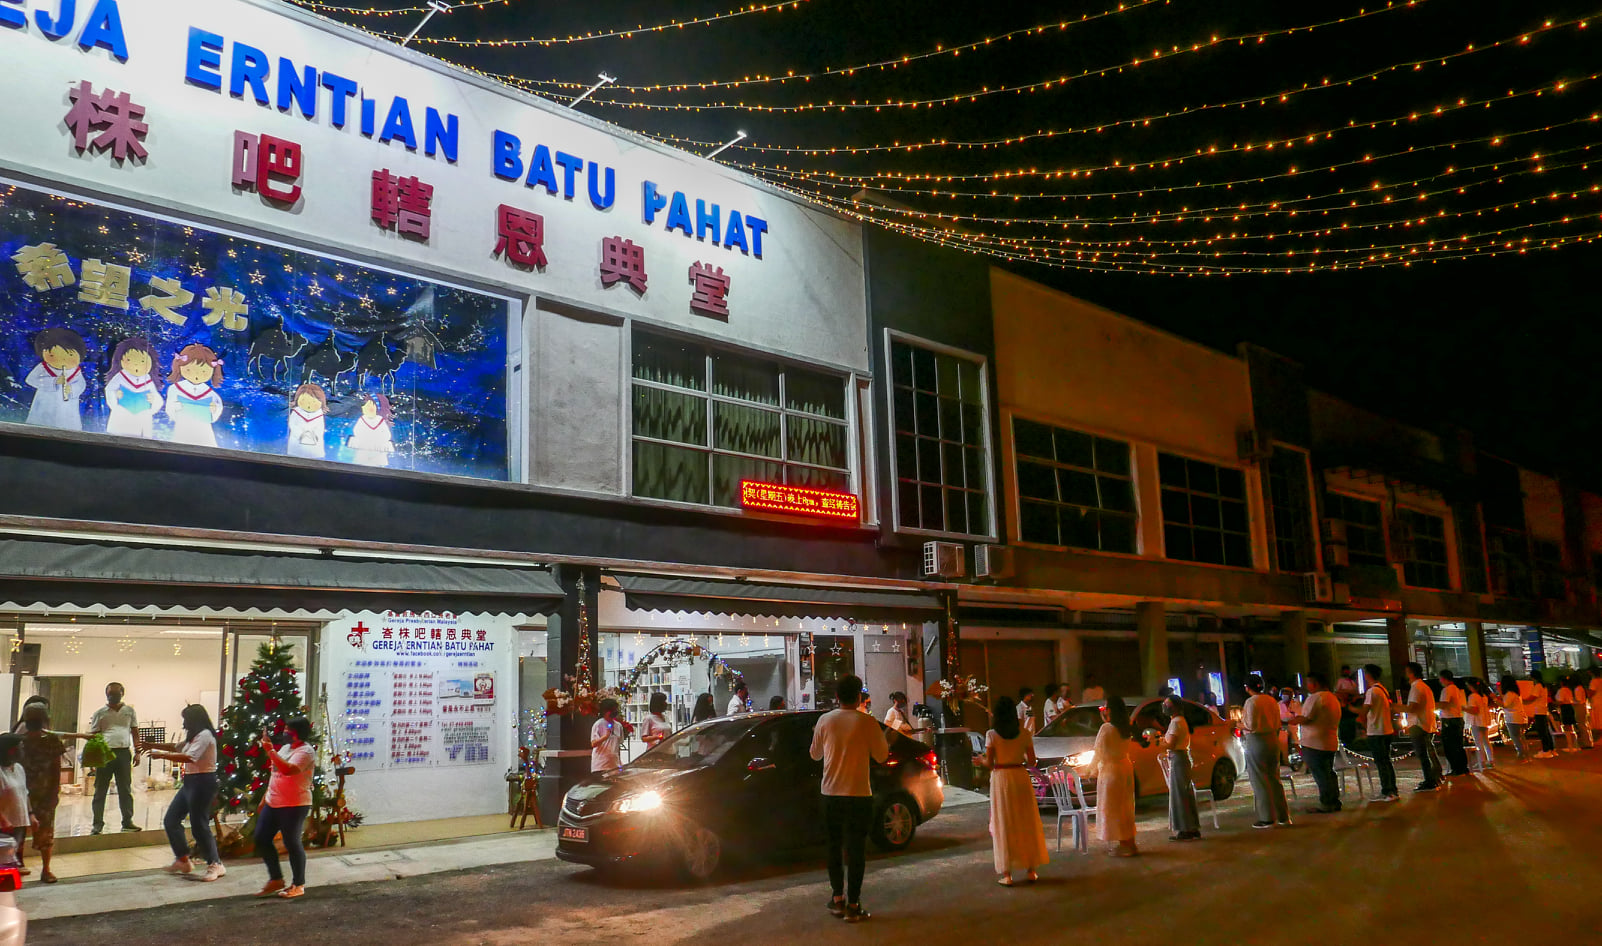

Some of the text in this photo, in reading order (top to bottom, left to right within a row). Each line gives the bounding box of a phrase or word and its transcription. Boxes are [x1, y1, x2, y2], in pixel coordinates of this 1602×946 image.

[185, 26, 459, 166] ERNTIAN
[493, 129, 616, 211] BATU
[643, 180, 768, 259] PAHAT
[10, 242, 249, 332] 希望之光
[372, 640, 495, 651] GEREJA ERNTIAN BATU PAHAT
